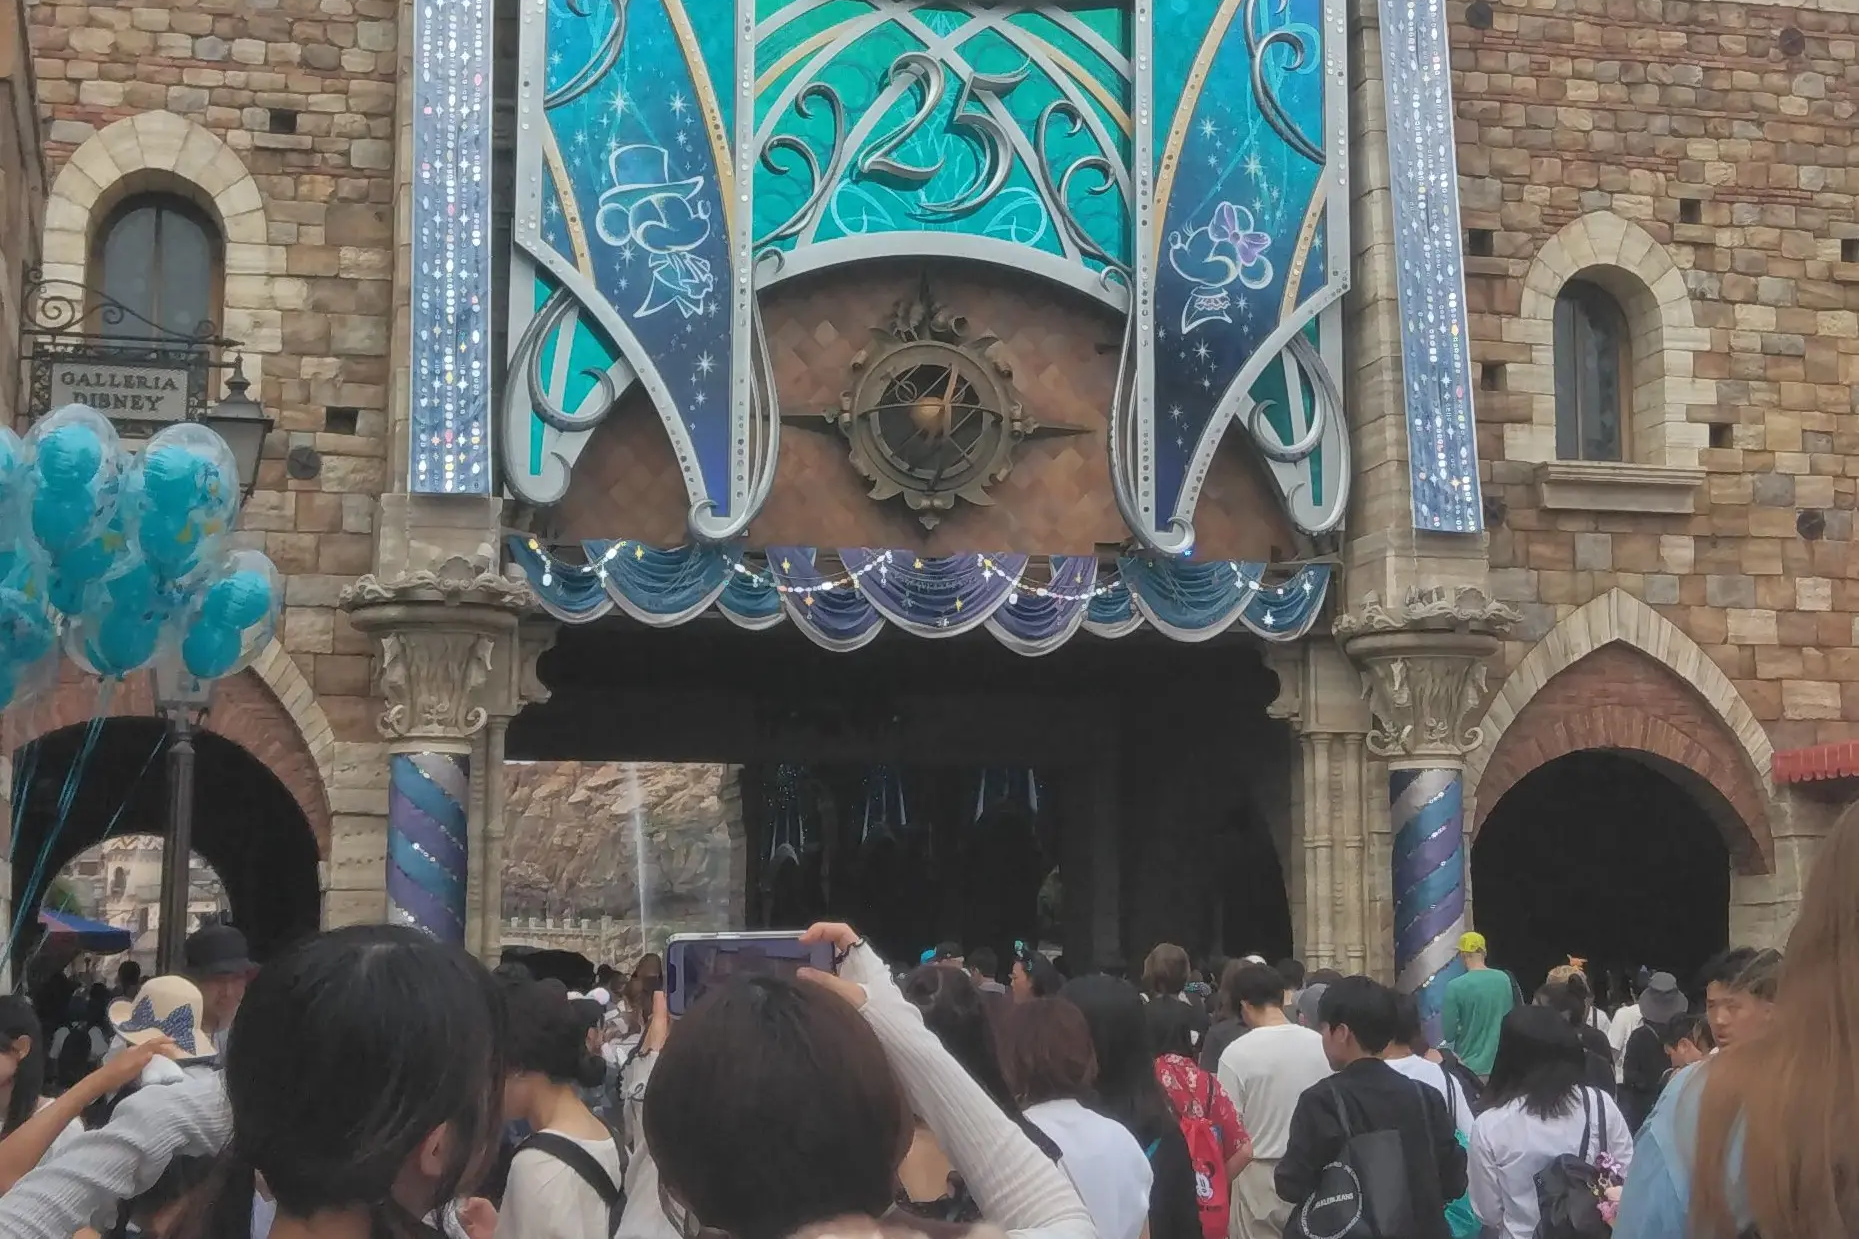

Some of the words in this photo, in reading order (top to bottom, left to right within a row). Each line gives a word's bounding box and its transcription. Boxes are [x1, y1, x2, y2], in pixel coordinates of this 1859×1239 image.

[857, 51, 1031, 214] 25
[61, 371, 178, 391] GALLERIA
[72, 391, 165, 412] DISNEY
